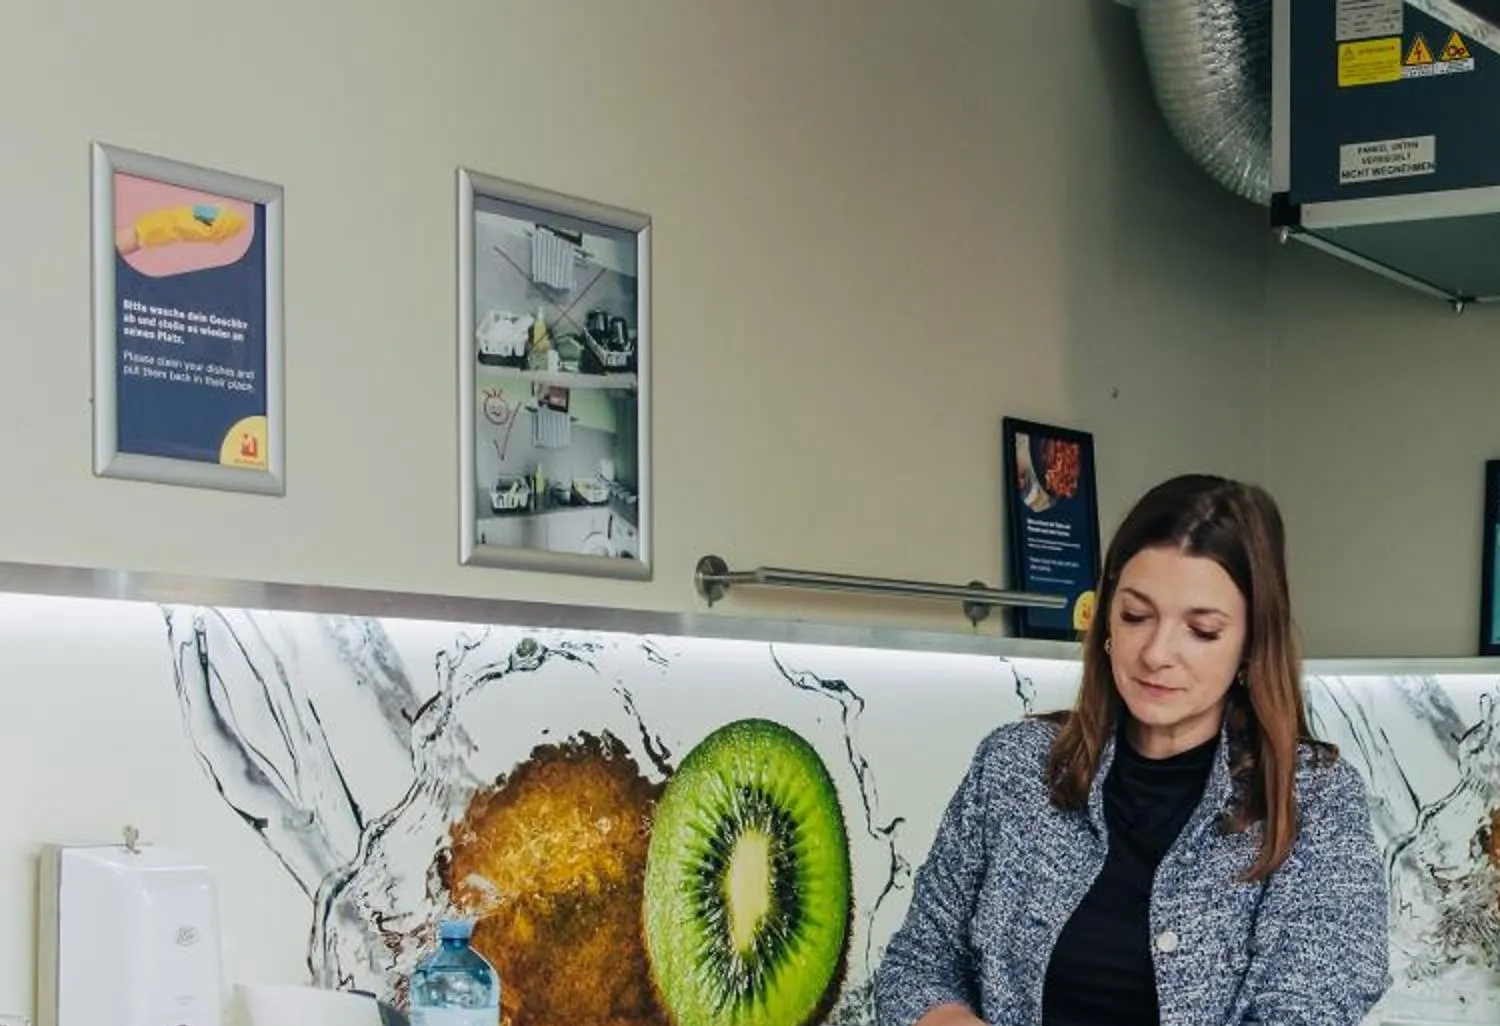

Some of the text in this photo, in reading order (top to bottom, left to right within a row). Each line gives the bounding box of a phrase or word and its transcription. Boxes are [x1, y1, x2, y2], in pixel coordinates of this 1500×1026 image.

[1341, 167, 1370, 179] NICHT
[123, 299, 148, 313] Bitte
[138, 316, 157, 327] und
[123, 350, 155, 365] Please
[184, 360, 204, 374] your
[123, 364, 140, 376] put
[169, 370, 191, 382] back
[193, 374, 203, 384] in
